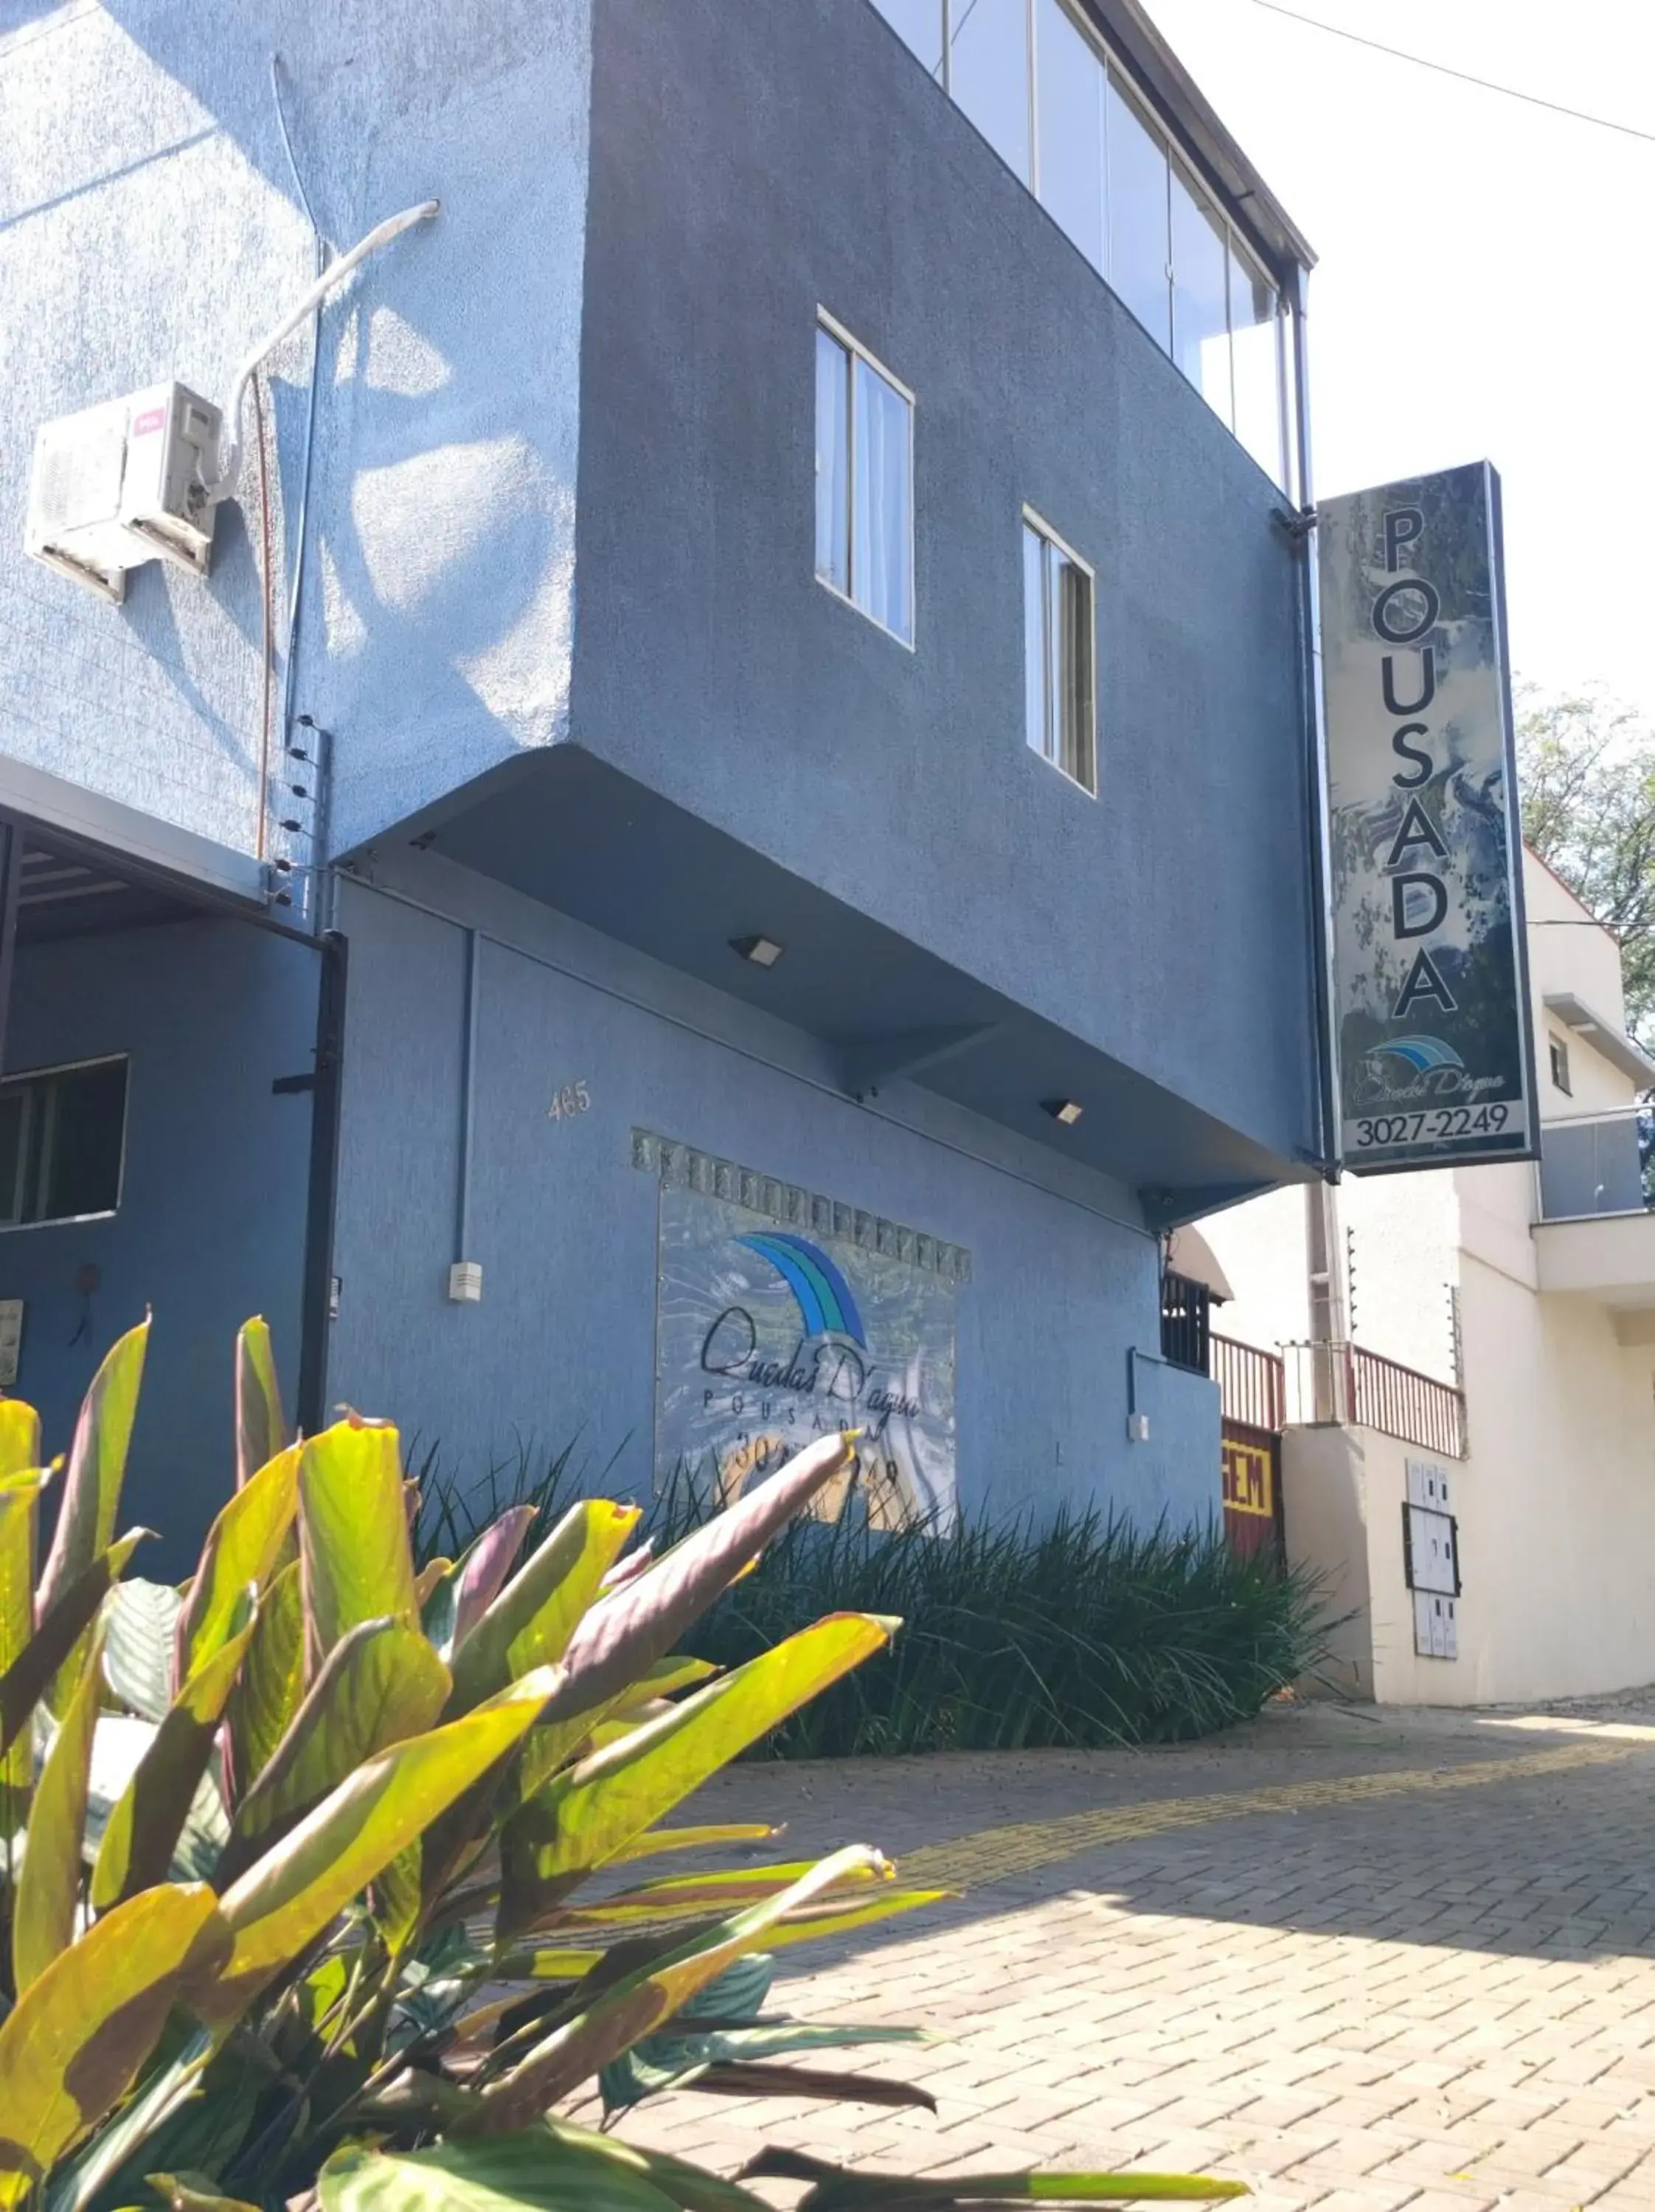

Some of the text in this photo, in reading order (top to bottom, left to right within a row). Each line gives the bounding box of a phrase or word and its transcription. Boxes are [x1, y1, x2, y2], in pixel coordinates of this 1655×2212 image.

[1372, 507, 1458, 1019] POUSADA
[548, 1079, 591, 1120] 465
[1357, 1105, 1508, 1147] 3027-2249
[701, 1306, 819, 1394] Quedas
